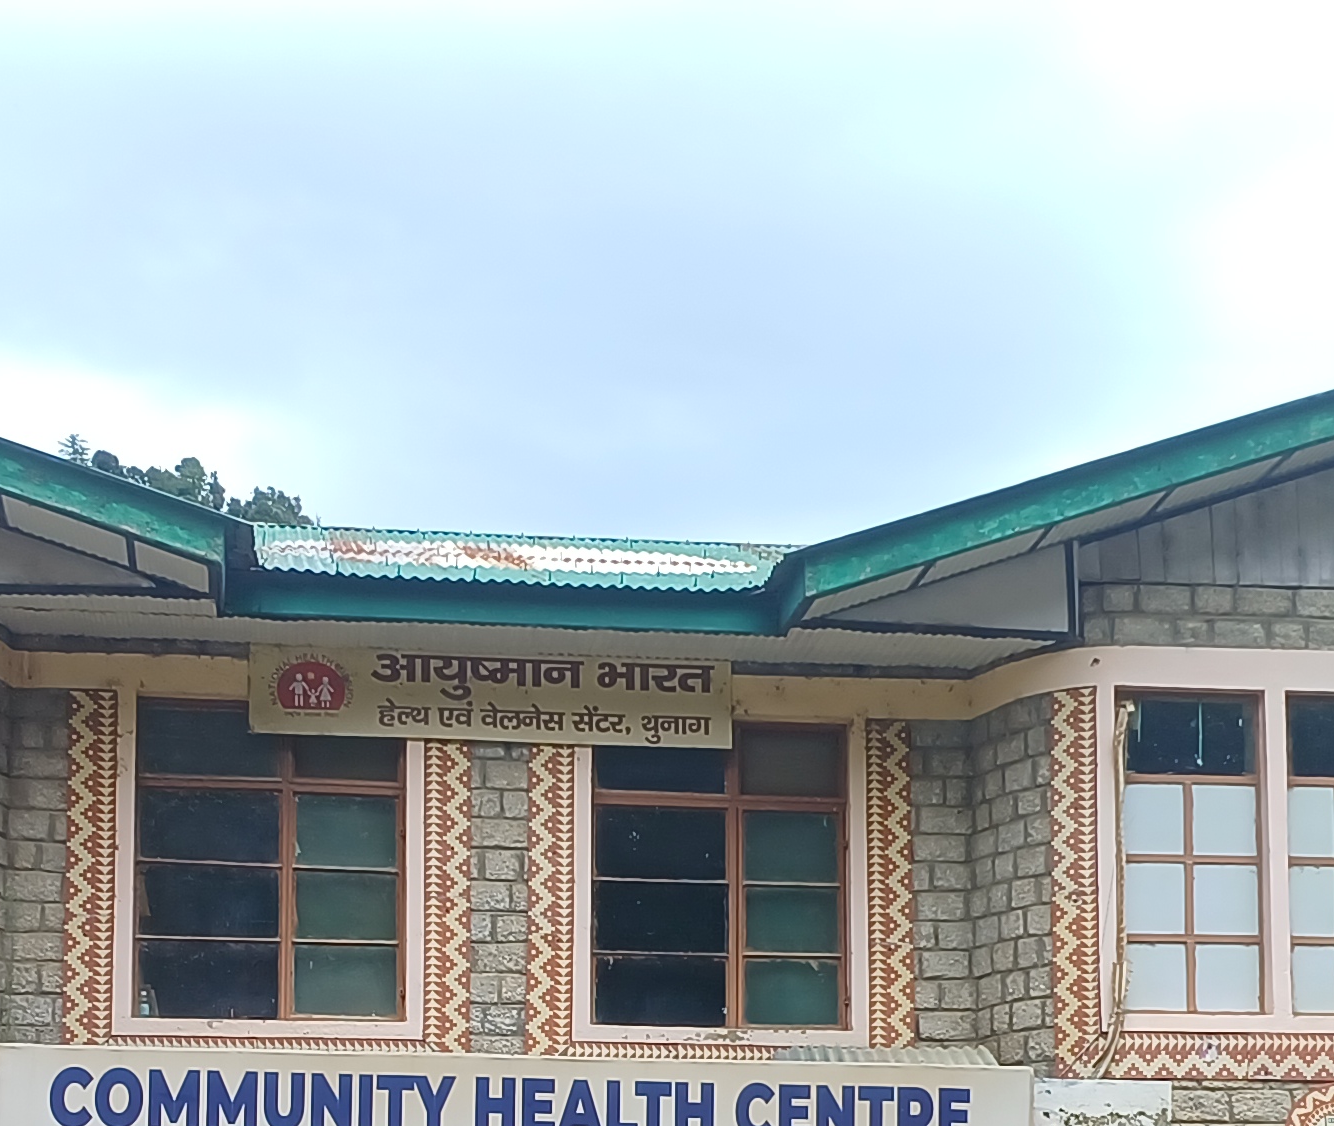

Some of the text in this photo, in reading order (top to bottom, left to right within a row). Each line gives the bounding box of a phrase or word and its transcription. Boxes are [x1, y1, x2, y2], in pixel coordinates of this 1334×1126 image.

[370, 653, 715, 701] आयुष्मान भारत
[377, 700, 711, 745] हेल्थ एवं वेलनेस सेंटर, थुनाग
